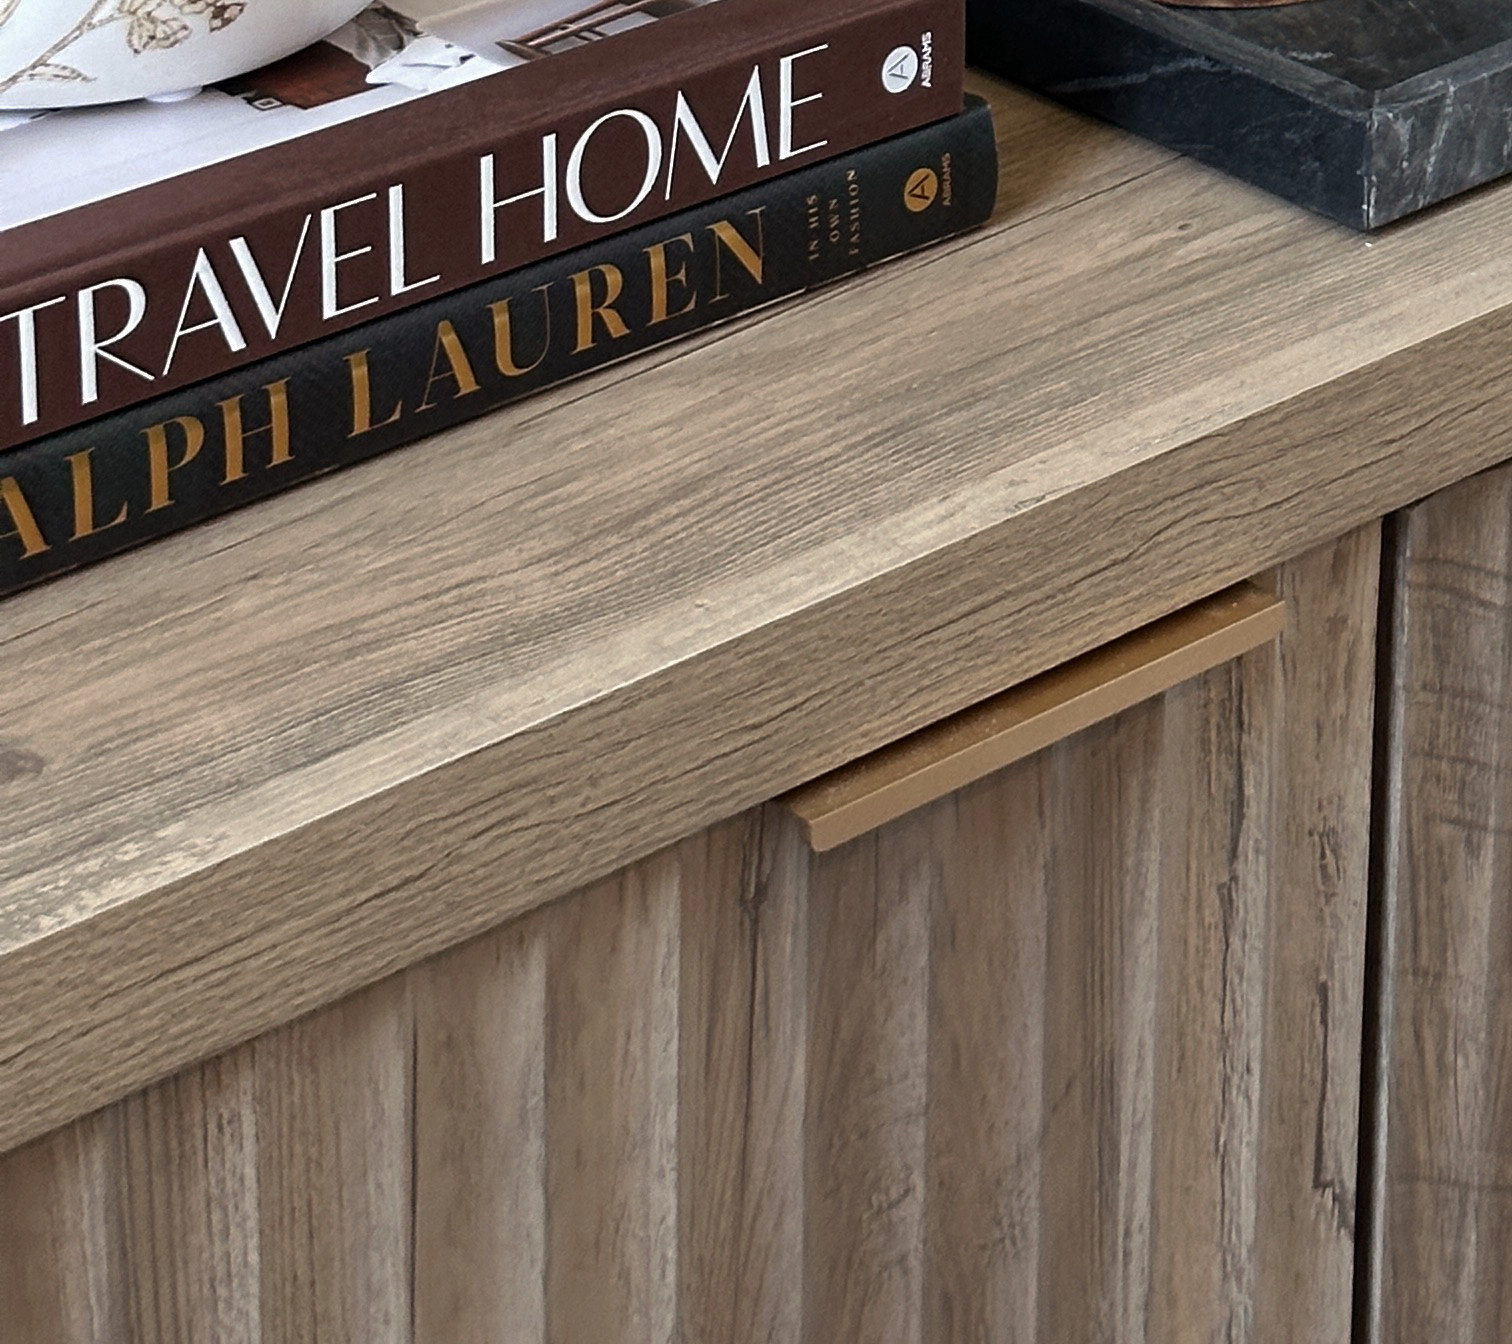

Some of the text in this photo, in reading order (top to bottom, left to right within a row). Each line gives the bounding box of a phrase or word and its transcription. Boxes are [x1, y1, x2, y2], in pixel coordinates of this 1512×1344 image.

[921, 31, 932, 88] ABRAMS
[846, 169, 860, 255] FASHION
[941, 152, 951, 206] ABRAMS
[0, 44, 829, 425] TRAVEL HOME
[806, 194, 820, 261] IN HIS
[828, 198, 840, 242] OWN
[342, 206, 766, 438] LAUREN
